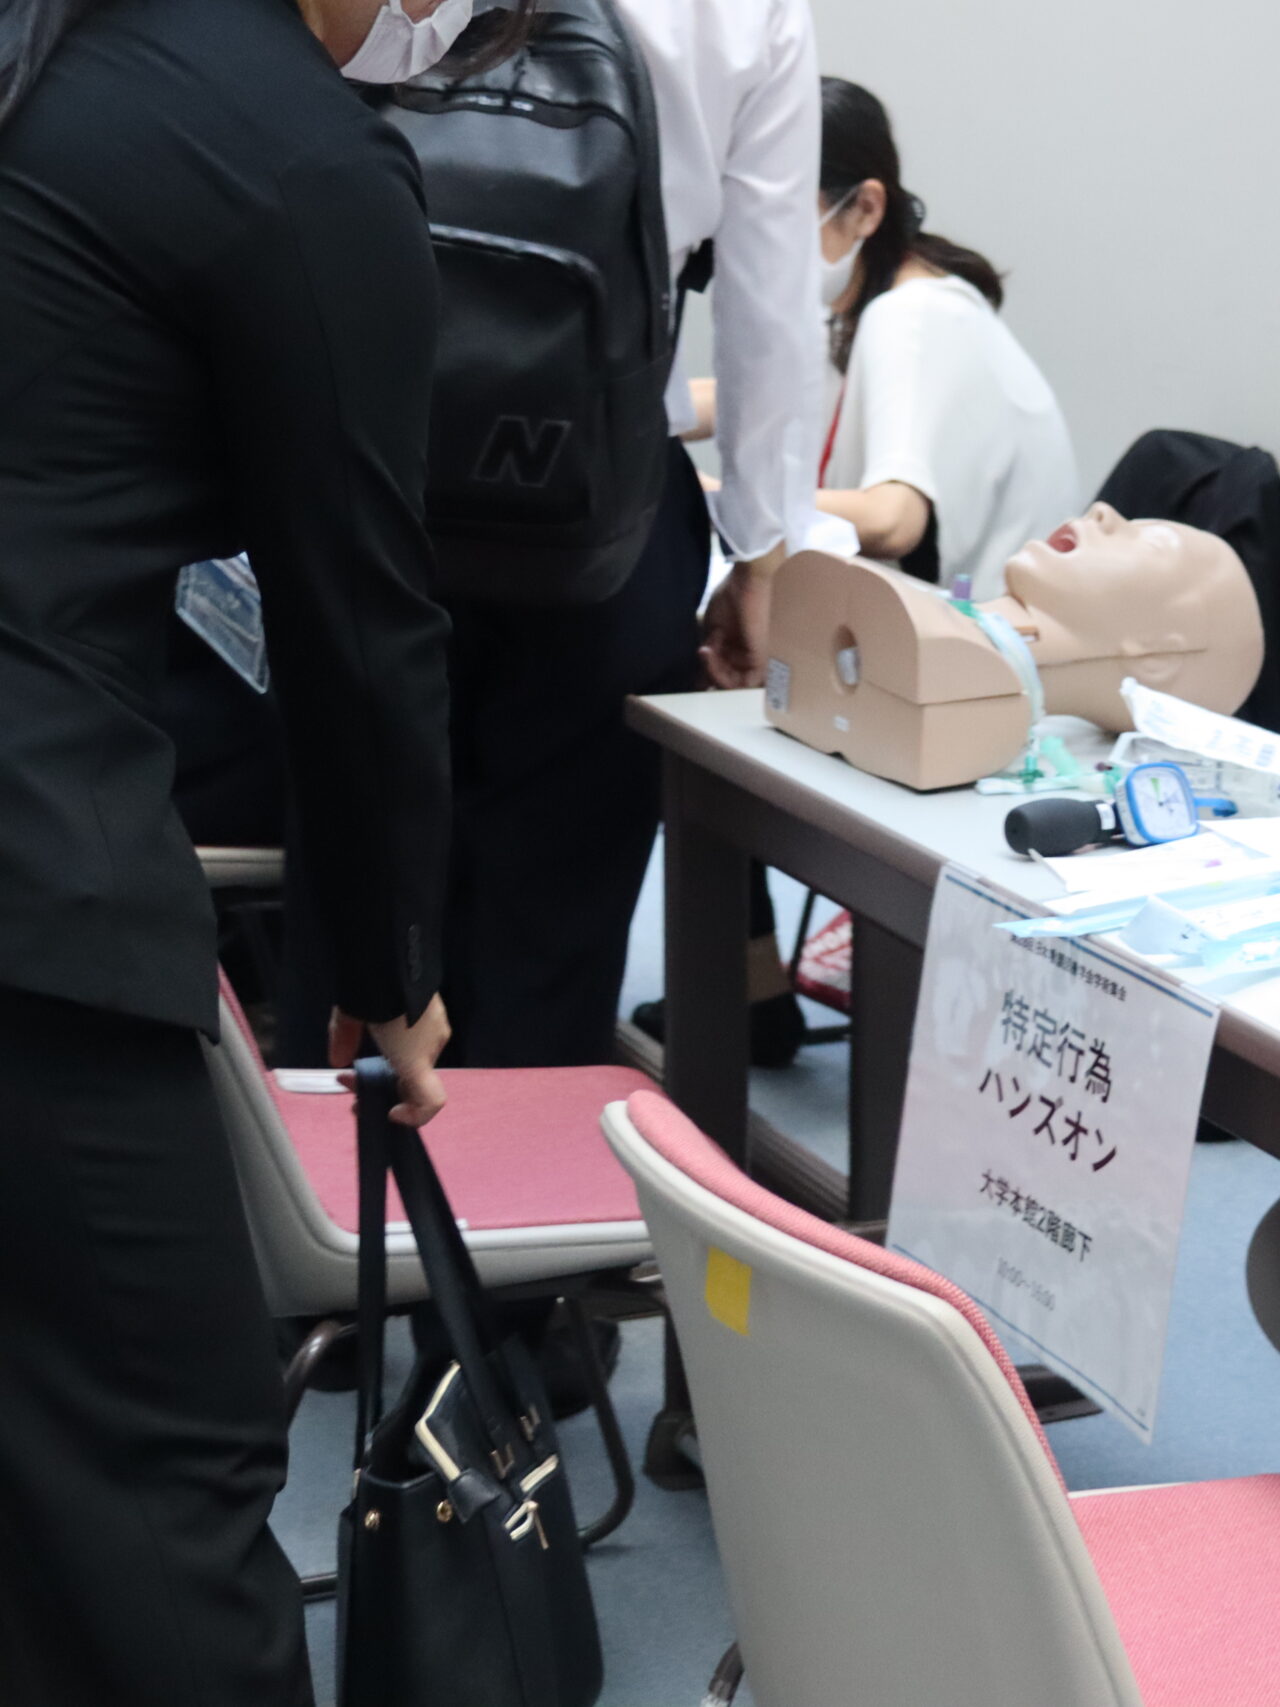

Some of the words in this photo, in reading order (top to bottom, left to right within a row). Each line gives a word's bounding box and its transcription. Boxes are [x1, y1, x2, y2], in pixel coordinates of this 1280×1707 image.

[999, 988, 1113, 1104] 特定行為
[978, 1067, 1118, 1173] ハンズオン
[978, 1167, 1093, 1263] 大学本館2階廊下
